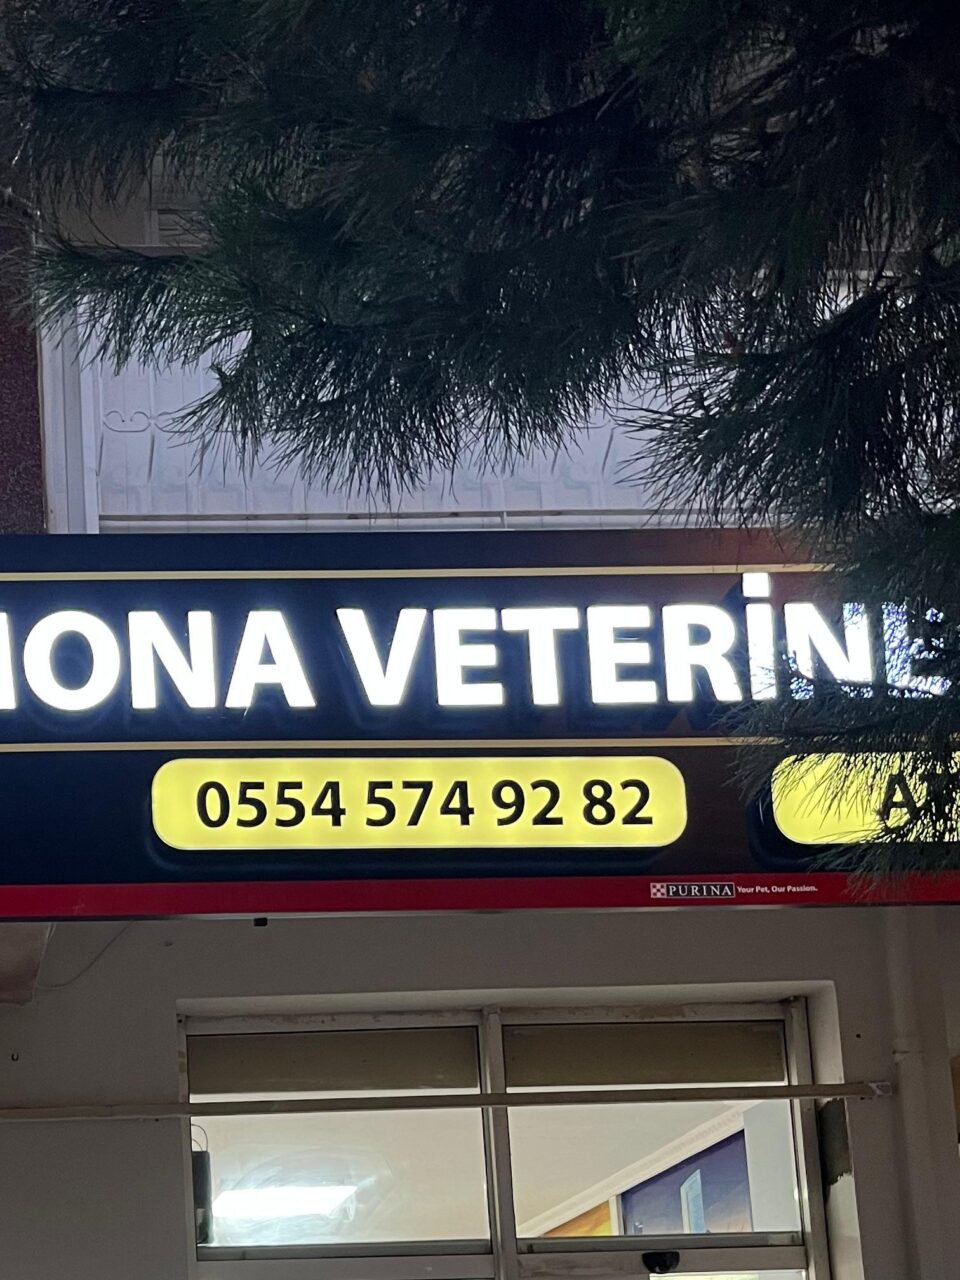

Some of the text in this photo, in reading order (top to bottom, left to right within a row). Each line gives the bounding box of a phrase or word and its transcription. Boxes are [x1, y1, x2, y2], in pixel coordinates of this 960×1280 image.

[196, 778, 653, 828] 0554 574 92 82
[668, 884, 732, 897] PURINA
[755, 886, 770, 894] Pet,
[787, 885, 818, 893] Passion.
